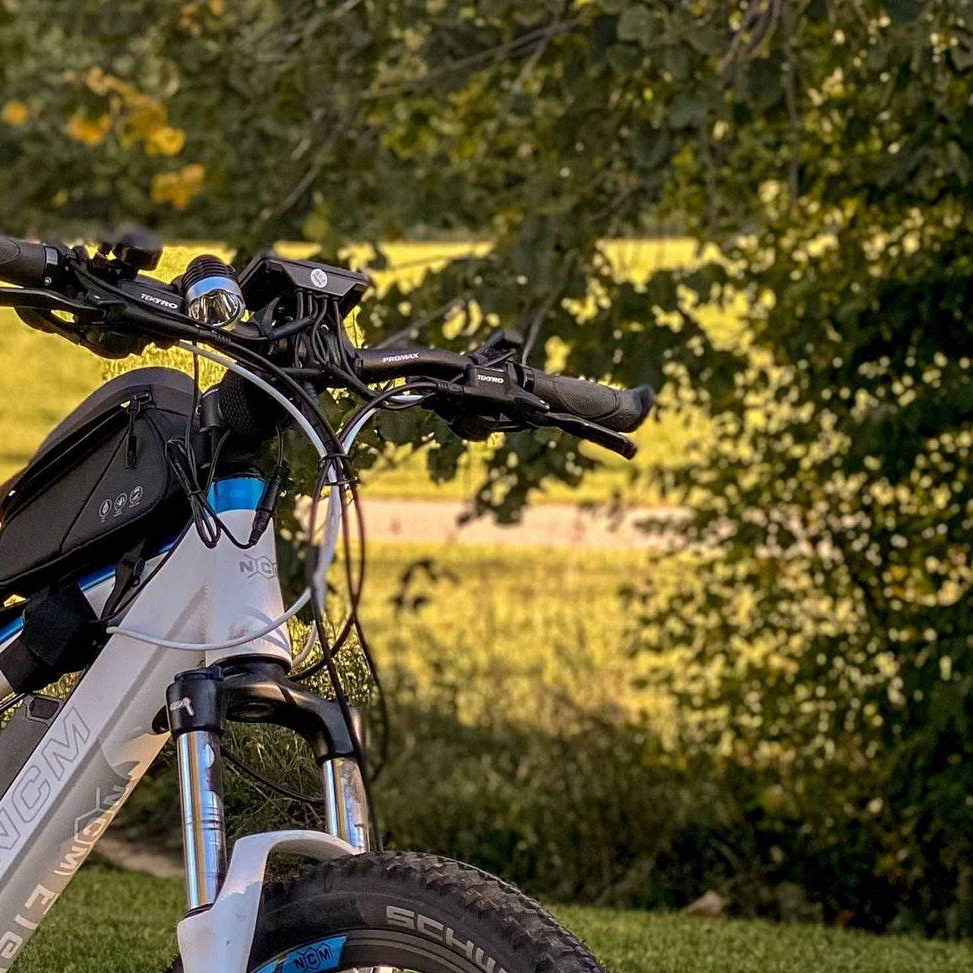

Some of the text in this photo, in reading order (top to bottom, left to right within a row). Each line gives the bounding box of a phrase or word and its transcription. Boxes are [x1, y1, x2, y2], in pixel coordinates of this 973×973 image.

[140, 293, 178, 309] TEKTRO
[383, 352, 419, 363] PROMAX
[477, 374, 504, 384] TEKTRO
[293, 946, 332, 970] NCM
